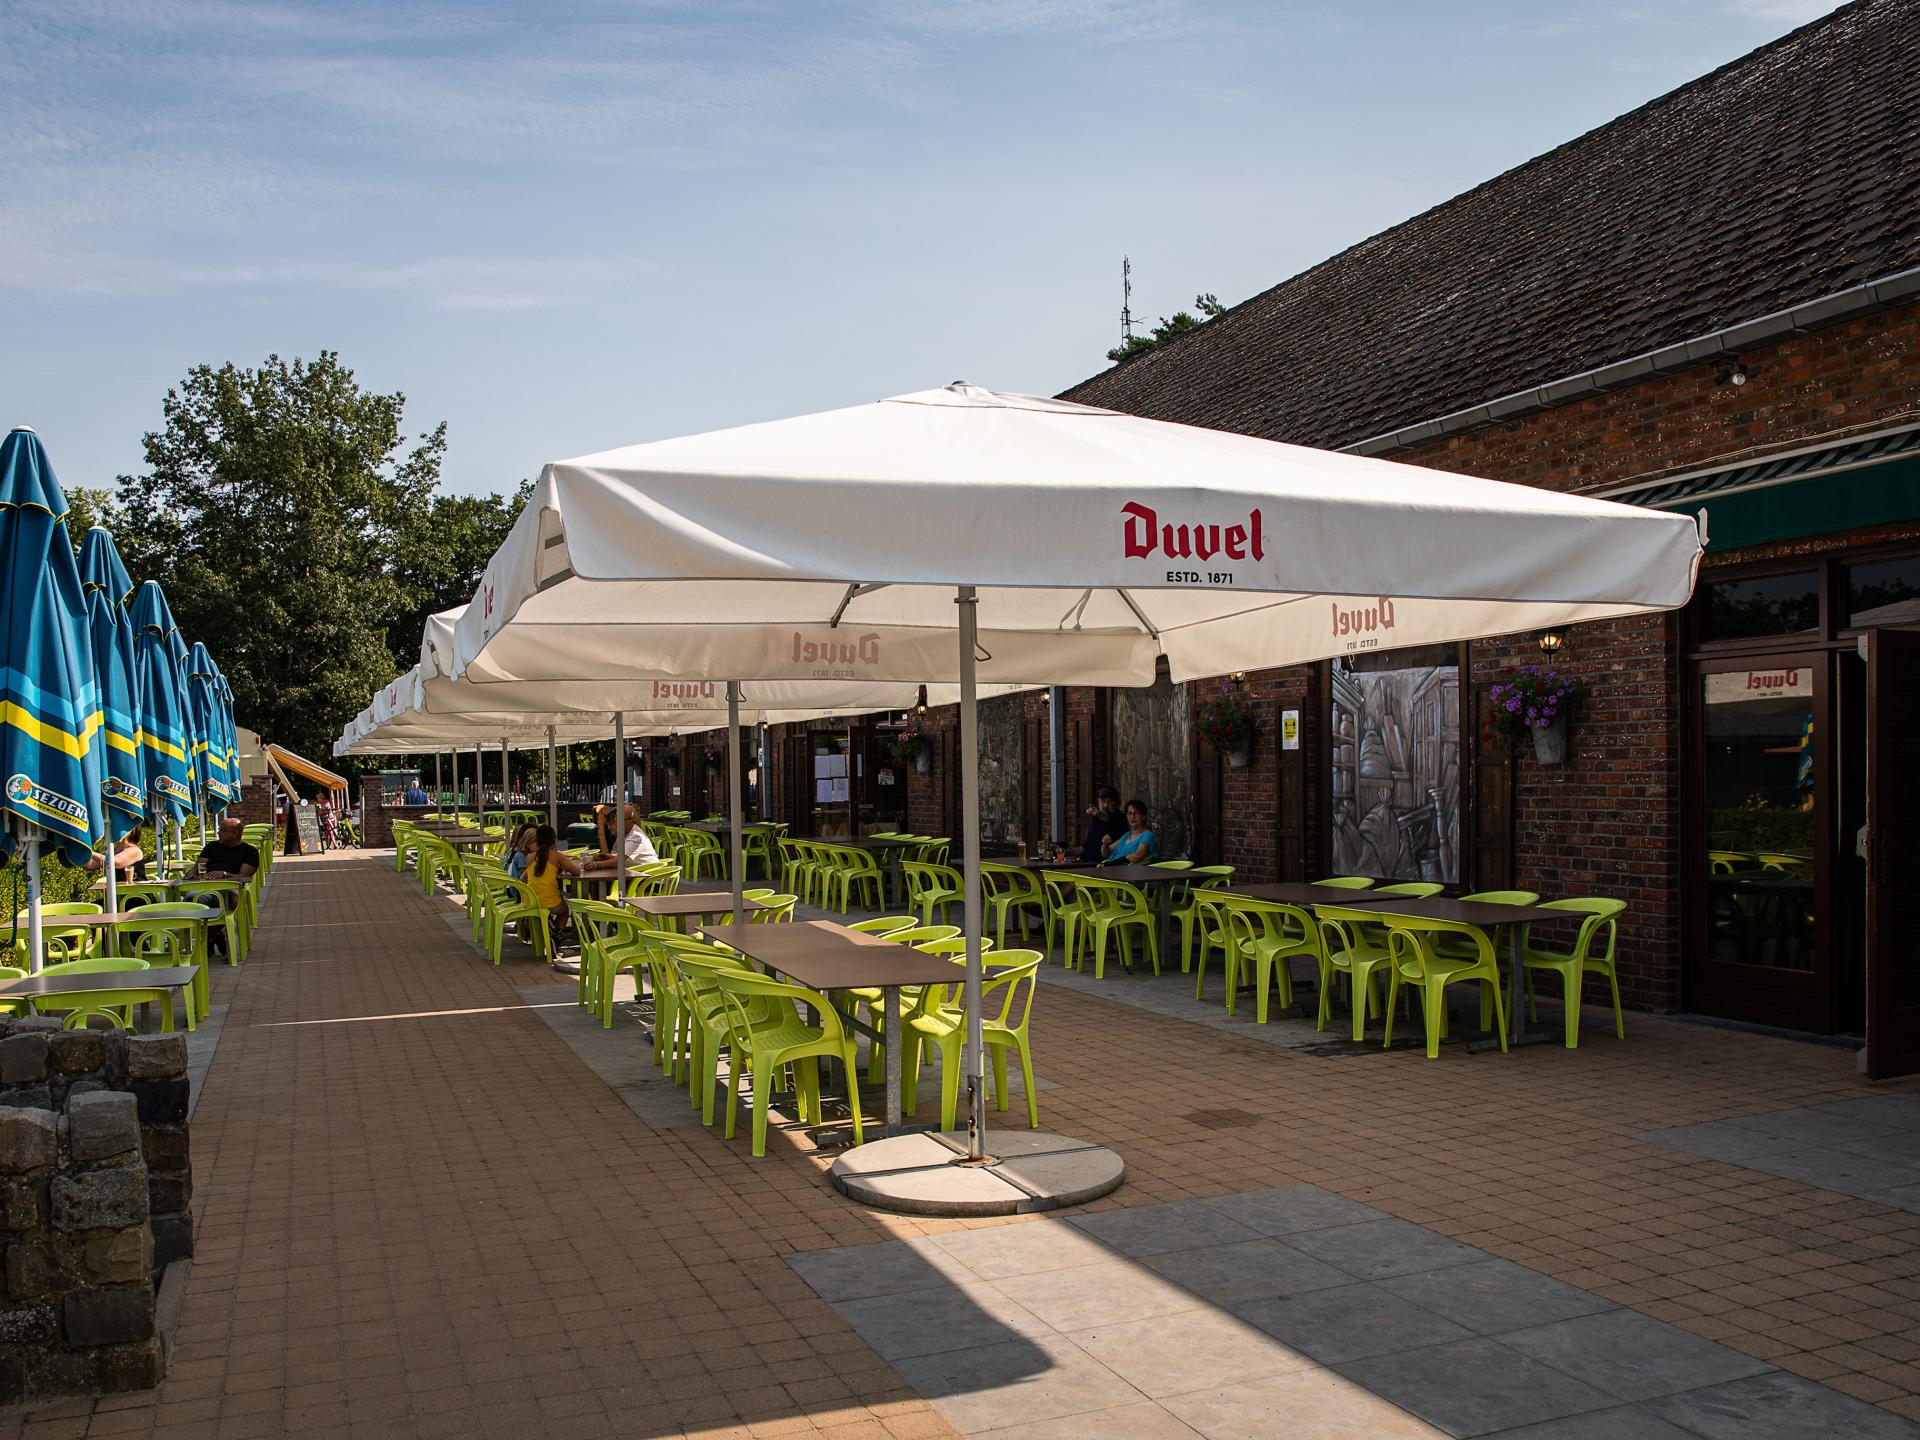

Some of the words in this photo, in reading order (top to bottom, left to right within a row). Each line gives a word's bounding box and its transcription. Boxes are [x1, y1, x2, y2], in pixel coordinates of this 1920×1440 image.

[1120, 501, 1264, 562] Duvel
[1166, 571, 1202, 583] ESTD.
[1207, 572, 1233, 584] 1871
[171, 782, 190, 796] SEZO
